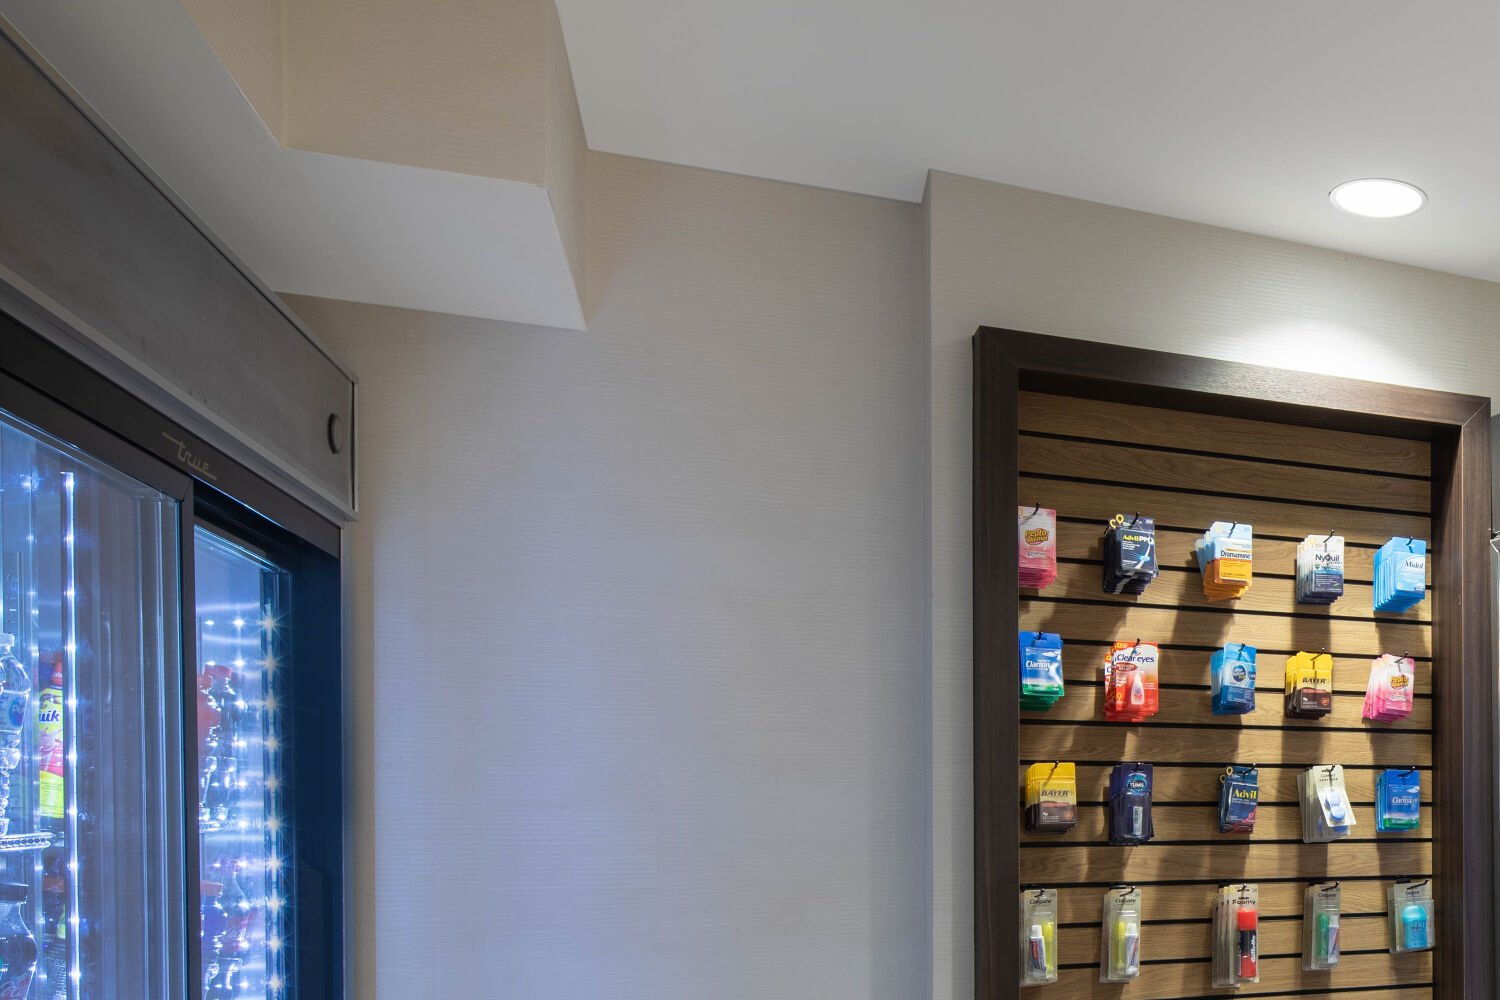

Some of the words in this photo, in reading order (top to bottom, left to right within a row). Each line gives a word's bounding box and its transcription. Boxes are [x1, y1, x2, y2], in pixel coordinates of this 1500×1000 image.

[177, 440, 211, 474] true
[1220, 550, 1250, 560] Dramamine
[1117, 654, 1135, 662] Clear
[1137, 655, 1154, 663] eyes
[1233, 789, 1256, 799] Advil
